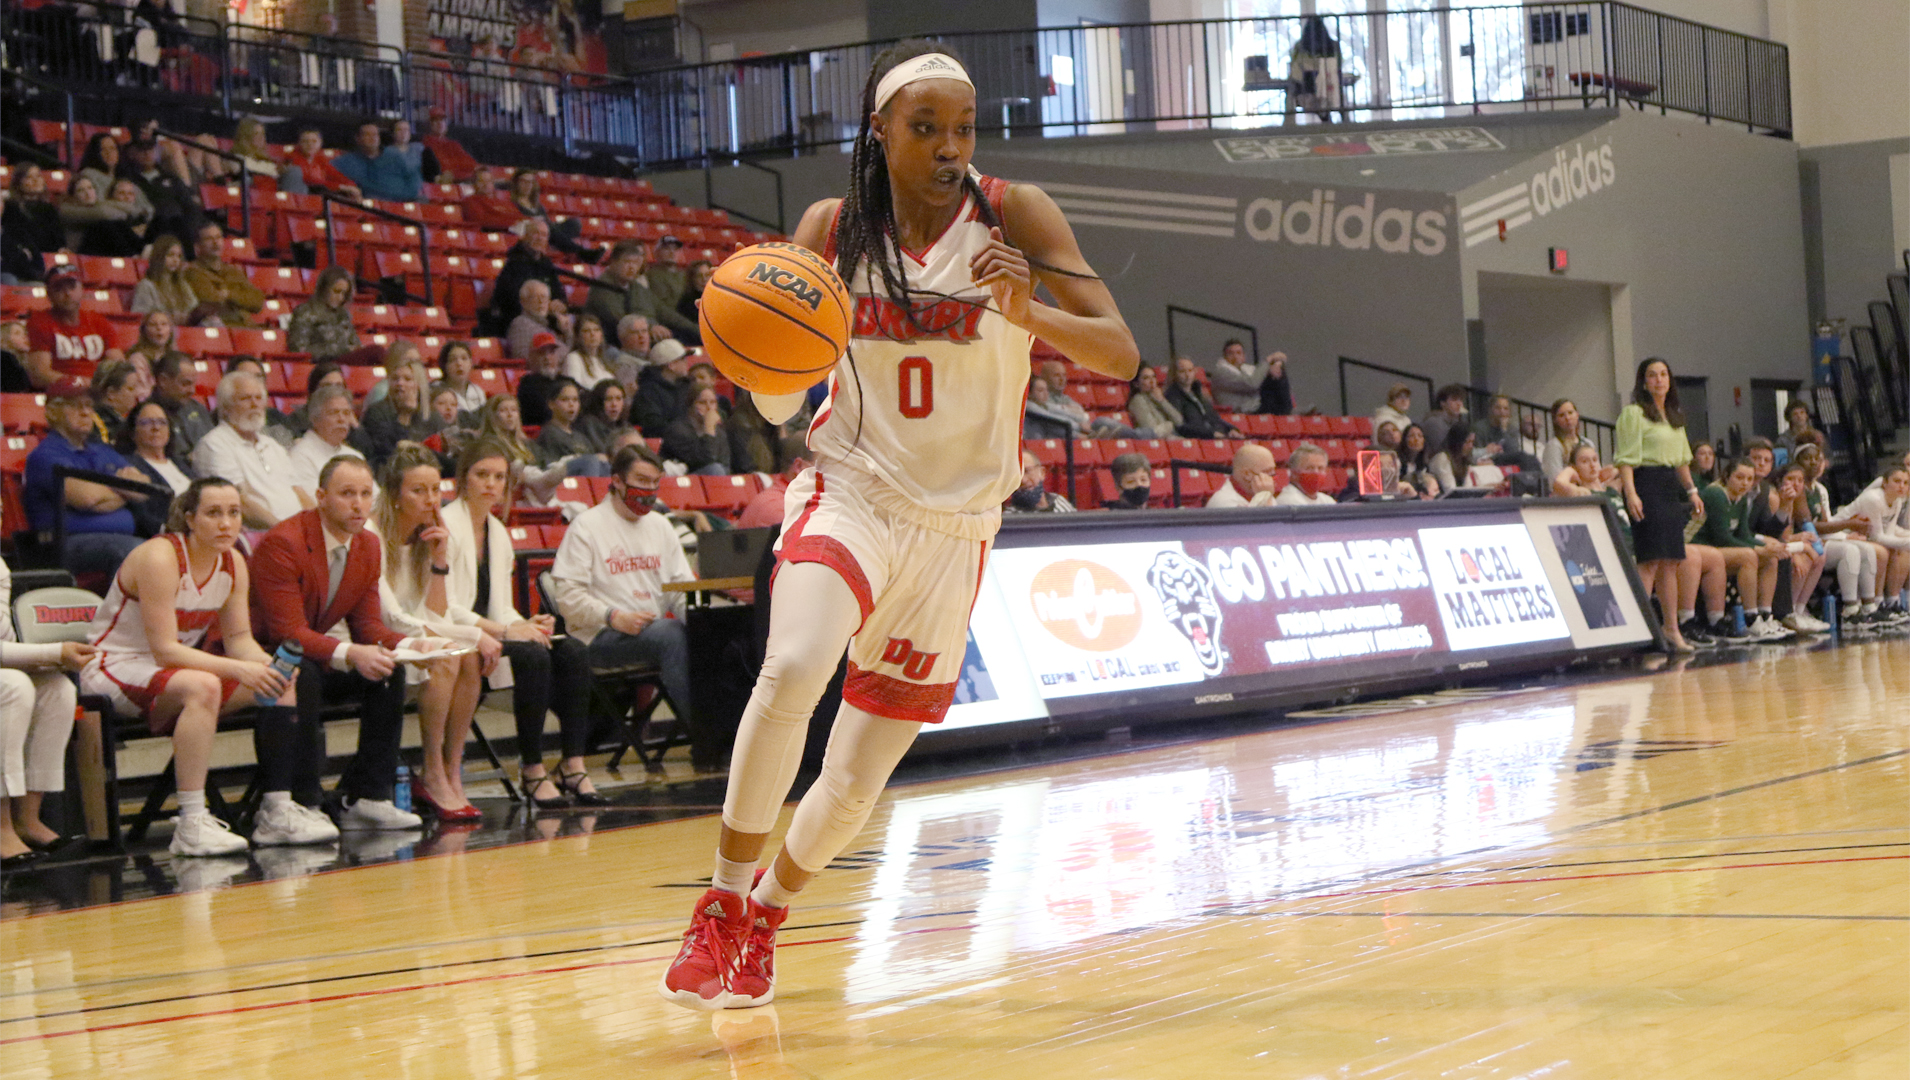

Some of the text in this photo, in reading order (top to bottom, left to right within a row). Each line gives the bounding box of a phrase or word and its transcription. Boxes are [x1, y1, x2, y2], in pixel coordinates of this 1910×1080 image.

[915, 63, 957, 73] adidas
[1532, 143, 1615, 216] adidas
[1244, 188, 1447, 256] adidas
[745, 261, 823, 311] NCAA
[853, 296, 989, 342] DRURY
[54, 333, 104, 361] DAD
[898, 356, 934, 419] 0
[1207, 546, 1266, 604] GO
[1258, 537, 1429, 600] PANTHERS!
[1445, 546, 1523, 585] LOCAL
[33, 604, 98, 624] DRURY
[1444, 583, 1556, 630] MATTERS
[880, 636, 942, 681] DU
